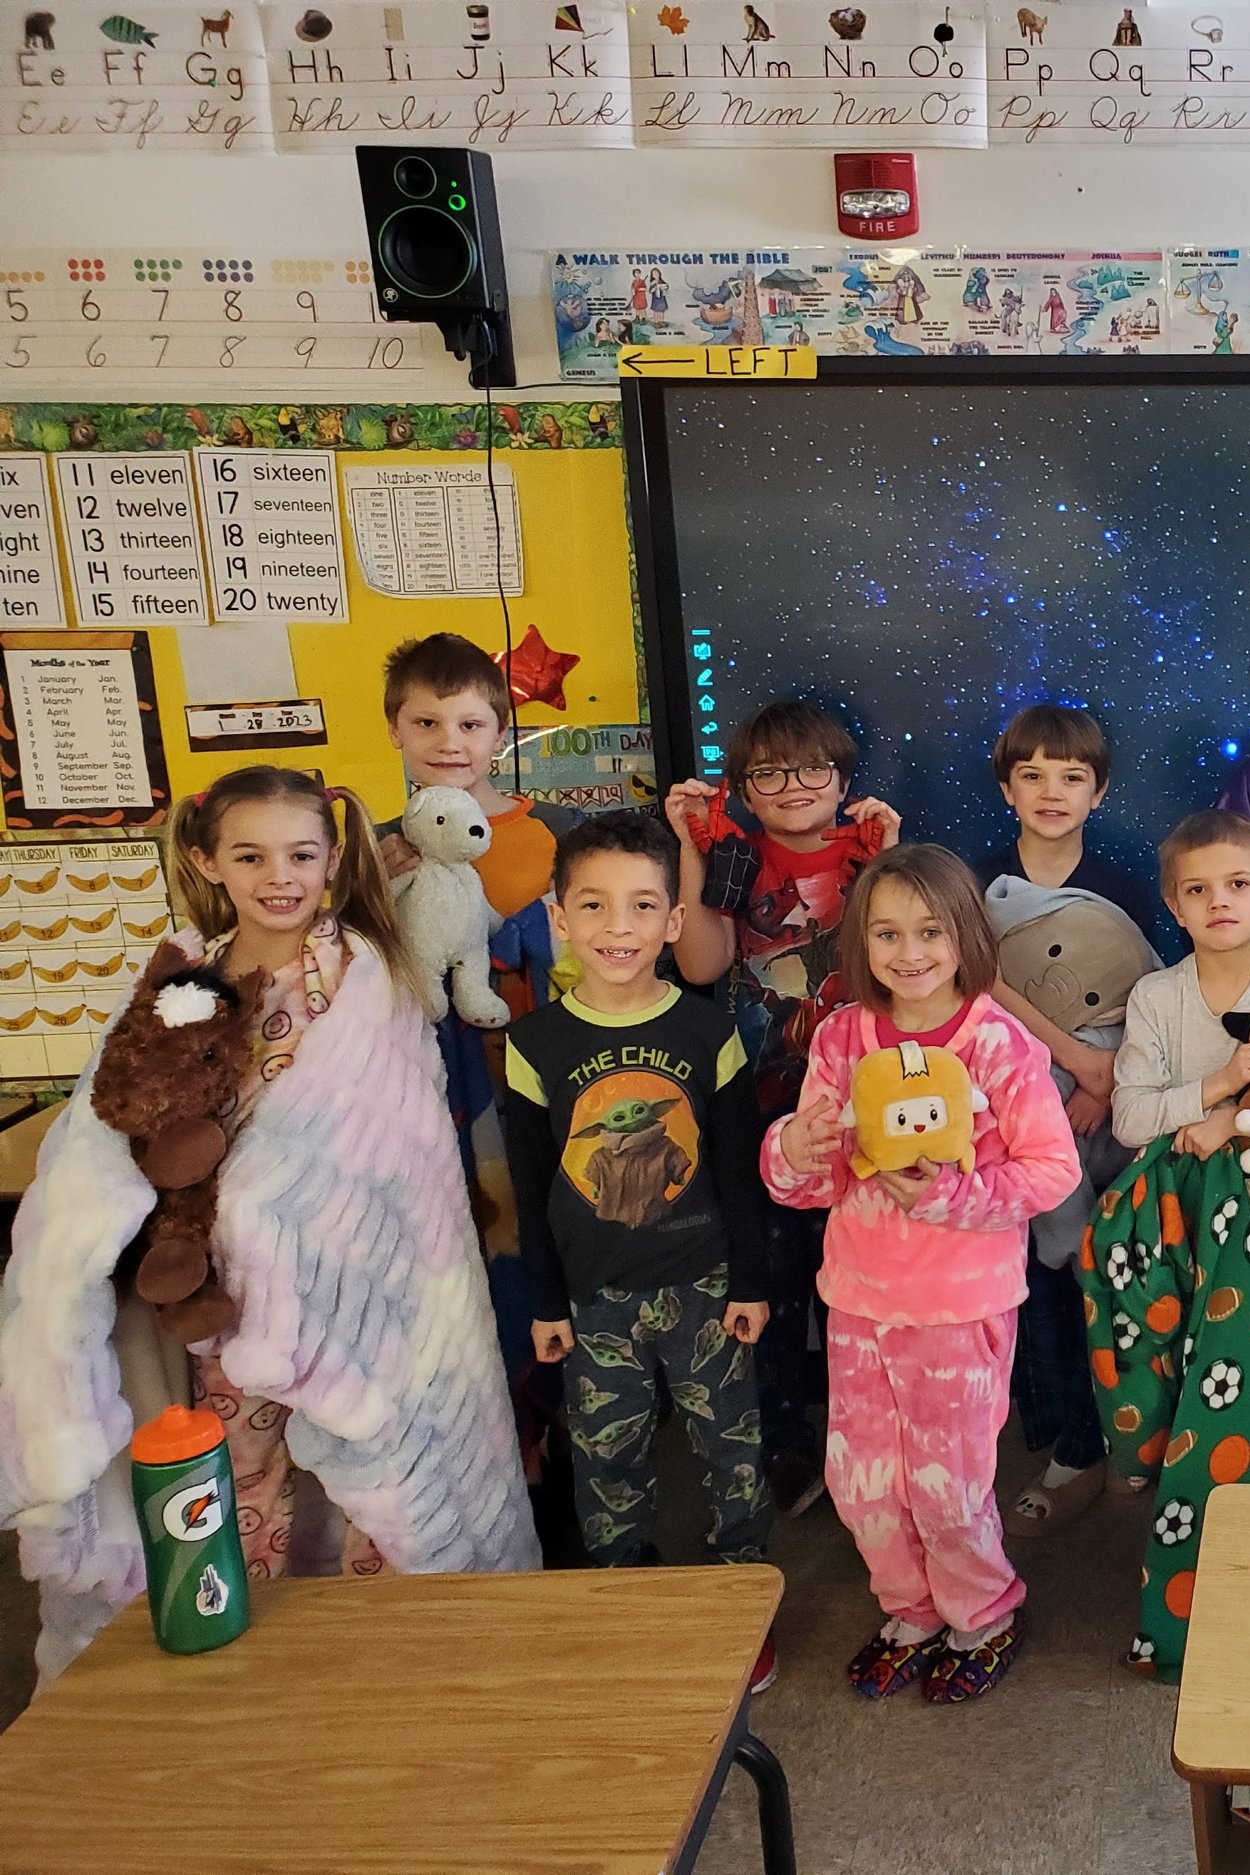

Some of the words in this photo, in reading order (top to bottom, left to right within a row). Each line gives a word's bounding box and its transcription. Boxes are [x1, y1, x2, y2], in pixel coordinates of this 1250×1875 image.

[860, 221, 896, 232] FIRE
[555, 253, 568, 266] A
[573, 253, 620, 266] WALK
[626, 253, 704, 265] THROUGH
[710, 253, 740, 265] THE
[746, 253, 790, 265] BIBLE
[1208, 250, 1229, 258] RUTH
[6, 290, 29, 323] 5
[81, 290, 101, 321] 6
[151, 290, 170, 322] 7
[224, 291, 243, 322] 8
[297, 291, 317, 323] 9
[4, 336, 37, 368] 5
[87, 336, 106, 368] 6
[150, 335, 170, 368] 7
[220, 336, 247, 369] 8
[295, 337, 317, 369] 9
[368, 337, 405, 369] 10
[705, 348, 797, 376] LEFT
[72, 463, 94, 486] 11
[110, 465, 184, 485] eleven
[213, 459, 236, 483] 16
[253, 462, 327, 482] sixteen
[377, 470, 432, 486] Number
[437, 469, 482, 483] Words
[77, 496, 99, 519] 12
[116, 498, 187, 518] twelve
[217, 491, 239, 514] 17
[254, 497, 332, 513] seventeen
[82, 528, 104, 552] 13
[120, 531, 192, 549] thirteen
[222, 524, 243, 547] 18
[258, 529, 336, 550] eighteen
[88, 561, 109, 584] 14
[123, 564, 199, 582] fourteen
[226, 556, 248, 579] 19
[261, 561, 338, 578] nineteen
[3, 598, 39, 616] ten
[93, 593, 114, 617] 15
[132, 594, 199, 615] fifteen
[223, 588, 256, 612] 20
[266, 592, 338, 616] twenty
[37, 675, 77, 684] January
[40, 686, 84, 695] February
[42, 697, 72, 705] March
[47, 708, 69, 717] April
[52, 719, 71, 728] May
[107, 718, 127, 728] May
[277, 714, 313, 727] 2023
[53, 730, 76, 738] June
[620, 731, 652, 751] DAY
[55, 740, 74, 749] July
[56, 751, 89, 761] August
[58, 762, 108, 771] September
[59, 773, 98, 781] October
[61, 784, 108, 792] November
[63, 796, 110, 804] December
[14, 849, 57, 861] THURSDAY
[70, 847, 98, 858] FRIDAY
[112, 845, 155, 857] SATURDAY
[37, 882, 44, 891] 5
[89, 881, 96, 890] 6
[137, 879, 144, 888] 7
[42, 929, 53, 938] 12
[90, 922, 102, 931] 13
[141, 928, 152, 937] 14
[53, 971, 64, 980] 19
[96, 967, 109, 976] 20
[8, 1021, 20, 1030] 25
[54, 1016, 67, 1025] 26
[568, 1049, 616, 1086] THE
[621, 1046, 693, 1081] CHILD
